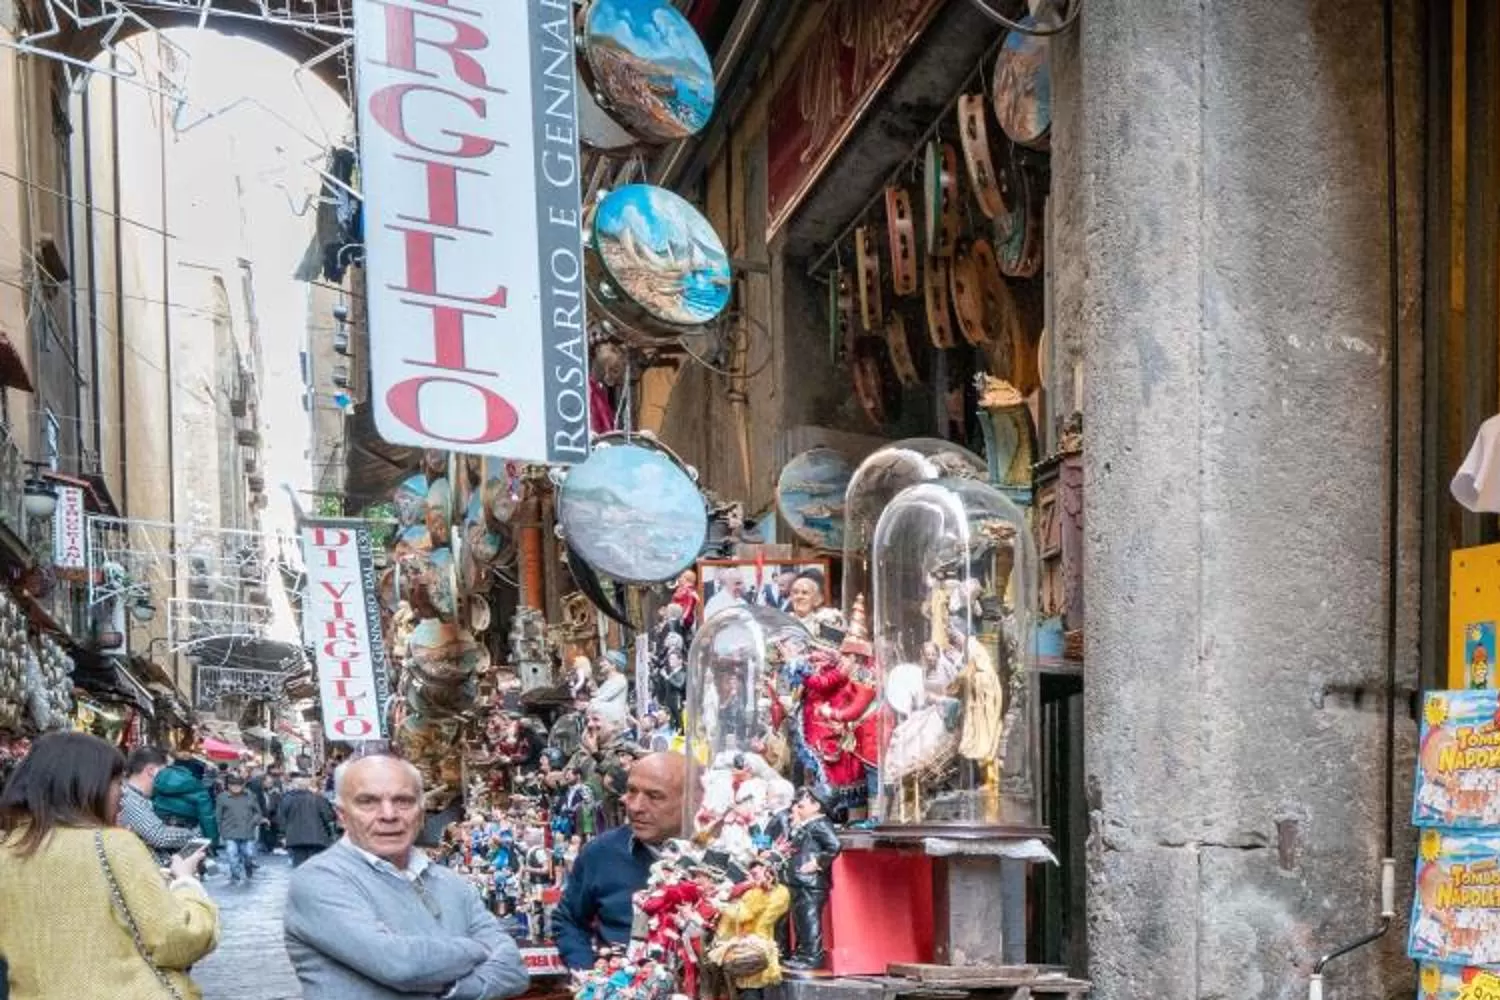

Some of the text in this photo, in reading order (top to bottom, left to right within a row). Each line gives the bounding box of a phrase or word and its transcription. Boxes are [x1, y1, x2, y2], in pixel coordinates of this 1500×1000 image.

[366, 0, 518, 444] RGILIO
[540, 0, 587, 455] ROSARIO E GENNA
[312, 526, 372, 736] DI VIRGILIO
